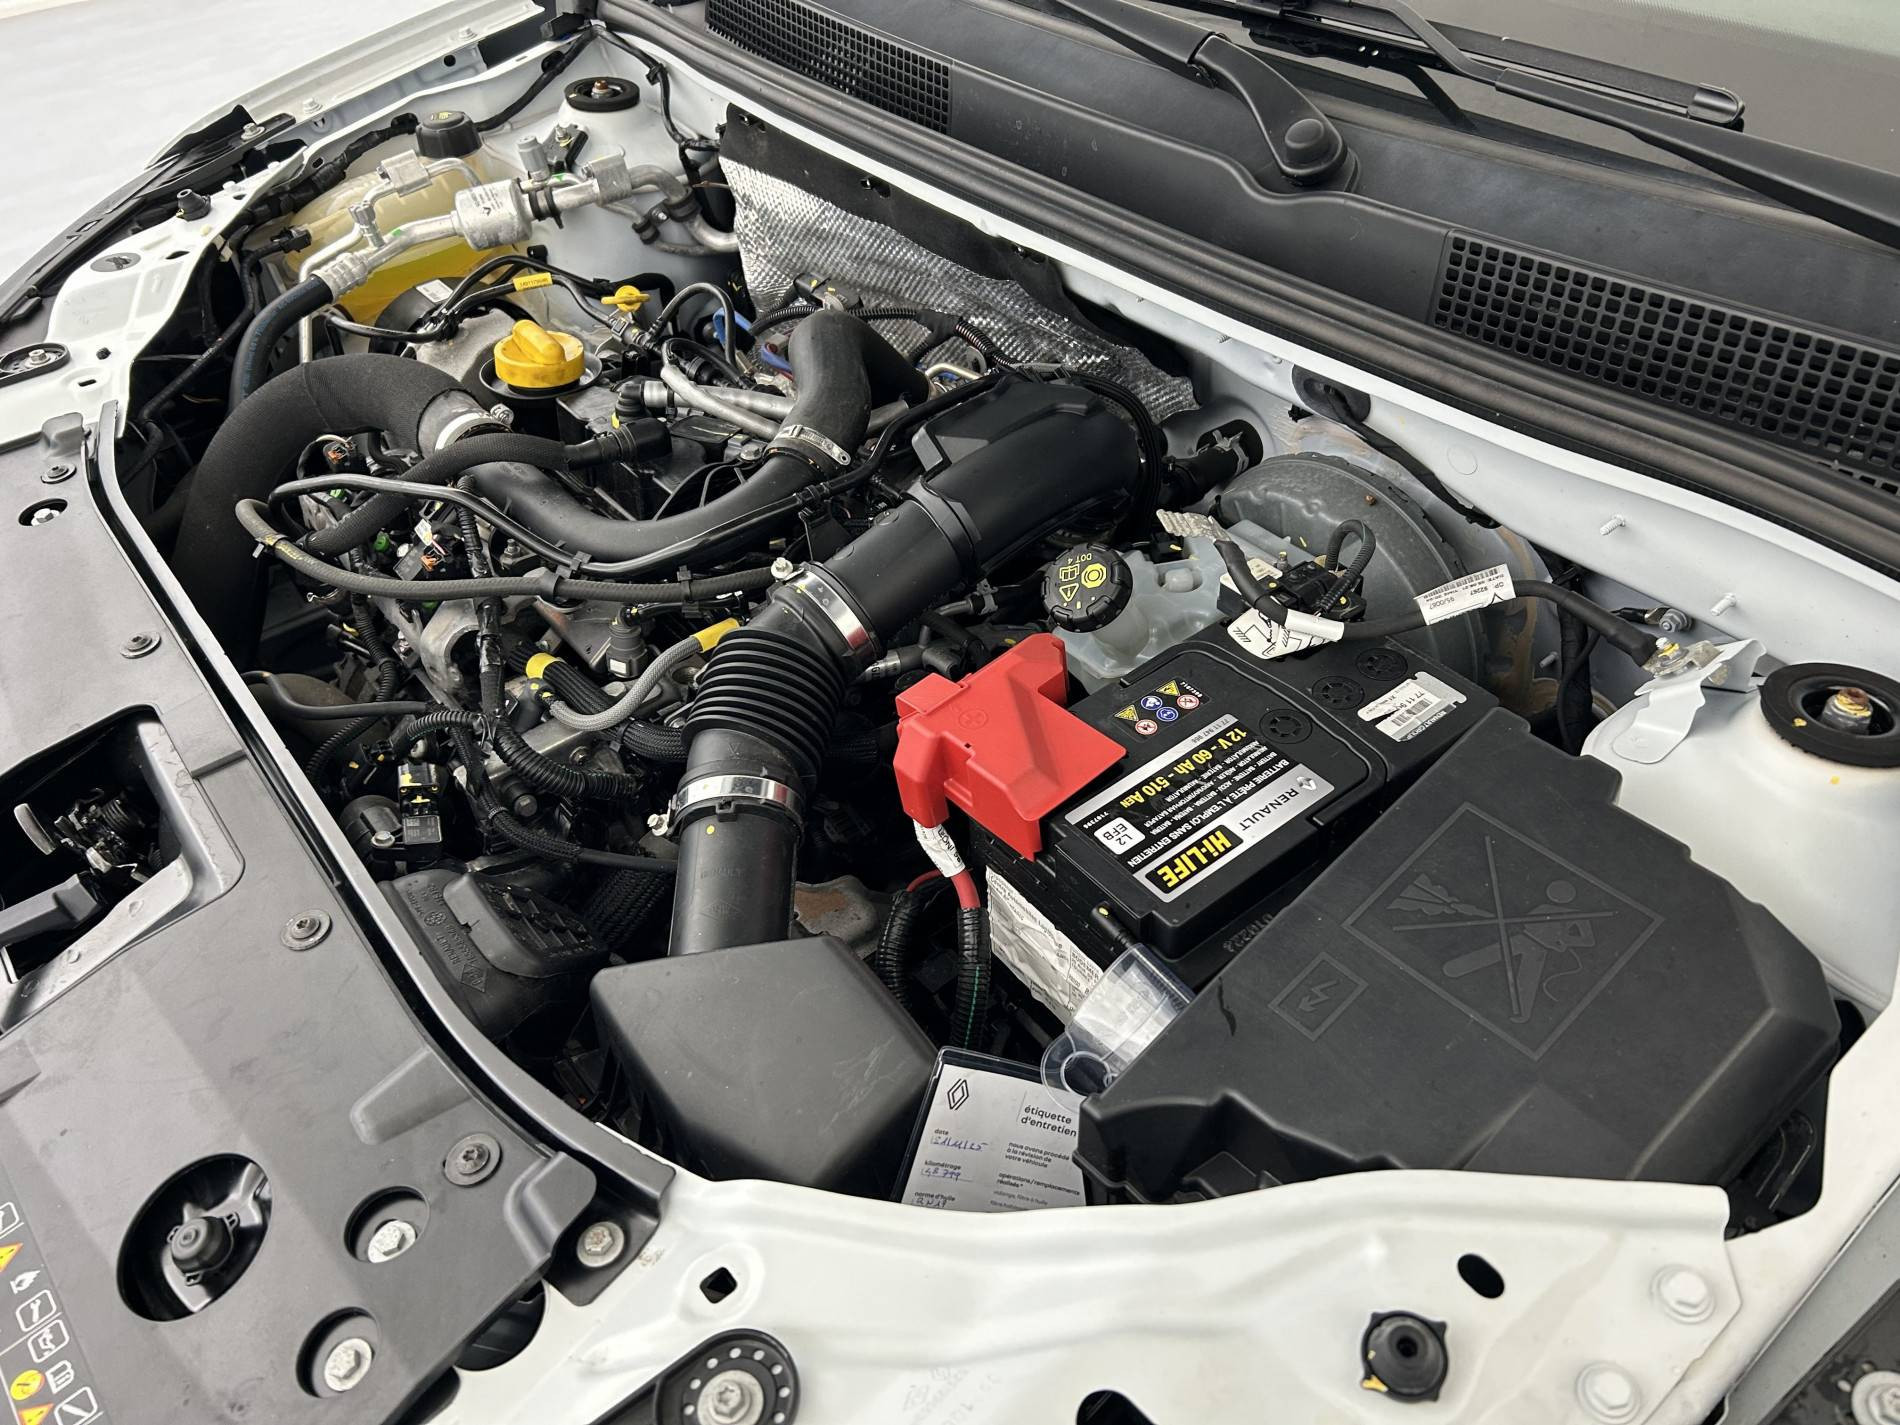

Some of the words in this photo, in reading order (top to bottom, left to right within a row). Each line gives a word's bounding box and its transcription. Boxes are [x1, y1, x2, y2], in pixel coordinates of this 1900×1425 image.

[1077, 553, 1092, 562] DOT
[1217, 738, 1233, 750] V
[1225, 728, 1247, 744] 12
[1191, 747, 1213, 765] 60
[1173, 758, 1195, 777] Ah
[1252, 759, 1290, 784] BATTERIE
[1141, 775, 1170, 797] 510
[1230, 781, 1255, 800] PRÊTE
[1189, 800, 1226, 827] L'EMPLOI
[1239, 787, 1299, 831] RENAULT
[1103, 823, 1128, 841] EFB
[1115, 834, 1133, 846] L2
[1169, 822, 1192, 840] SANS
[1127, 836, 1171, 867] ENTRETIEN
[1156, 829, 1233, 888] Hi-LIFE
[1025, 1105, 1071, 1124] étiquette
[1021, 1117, 1076, 1136] d'entretien
[1043, 1149, 1069, 1161] procédé
